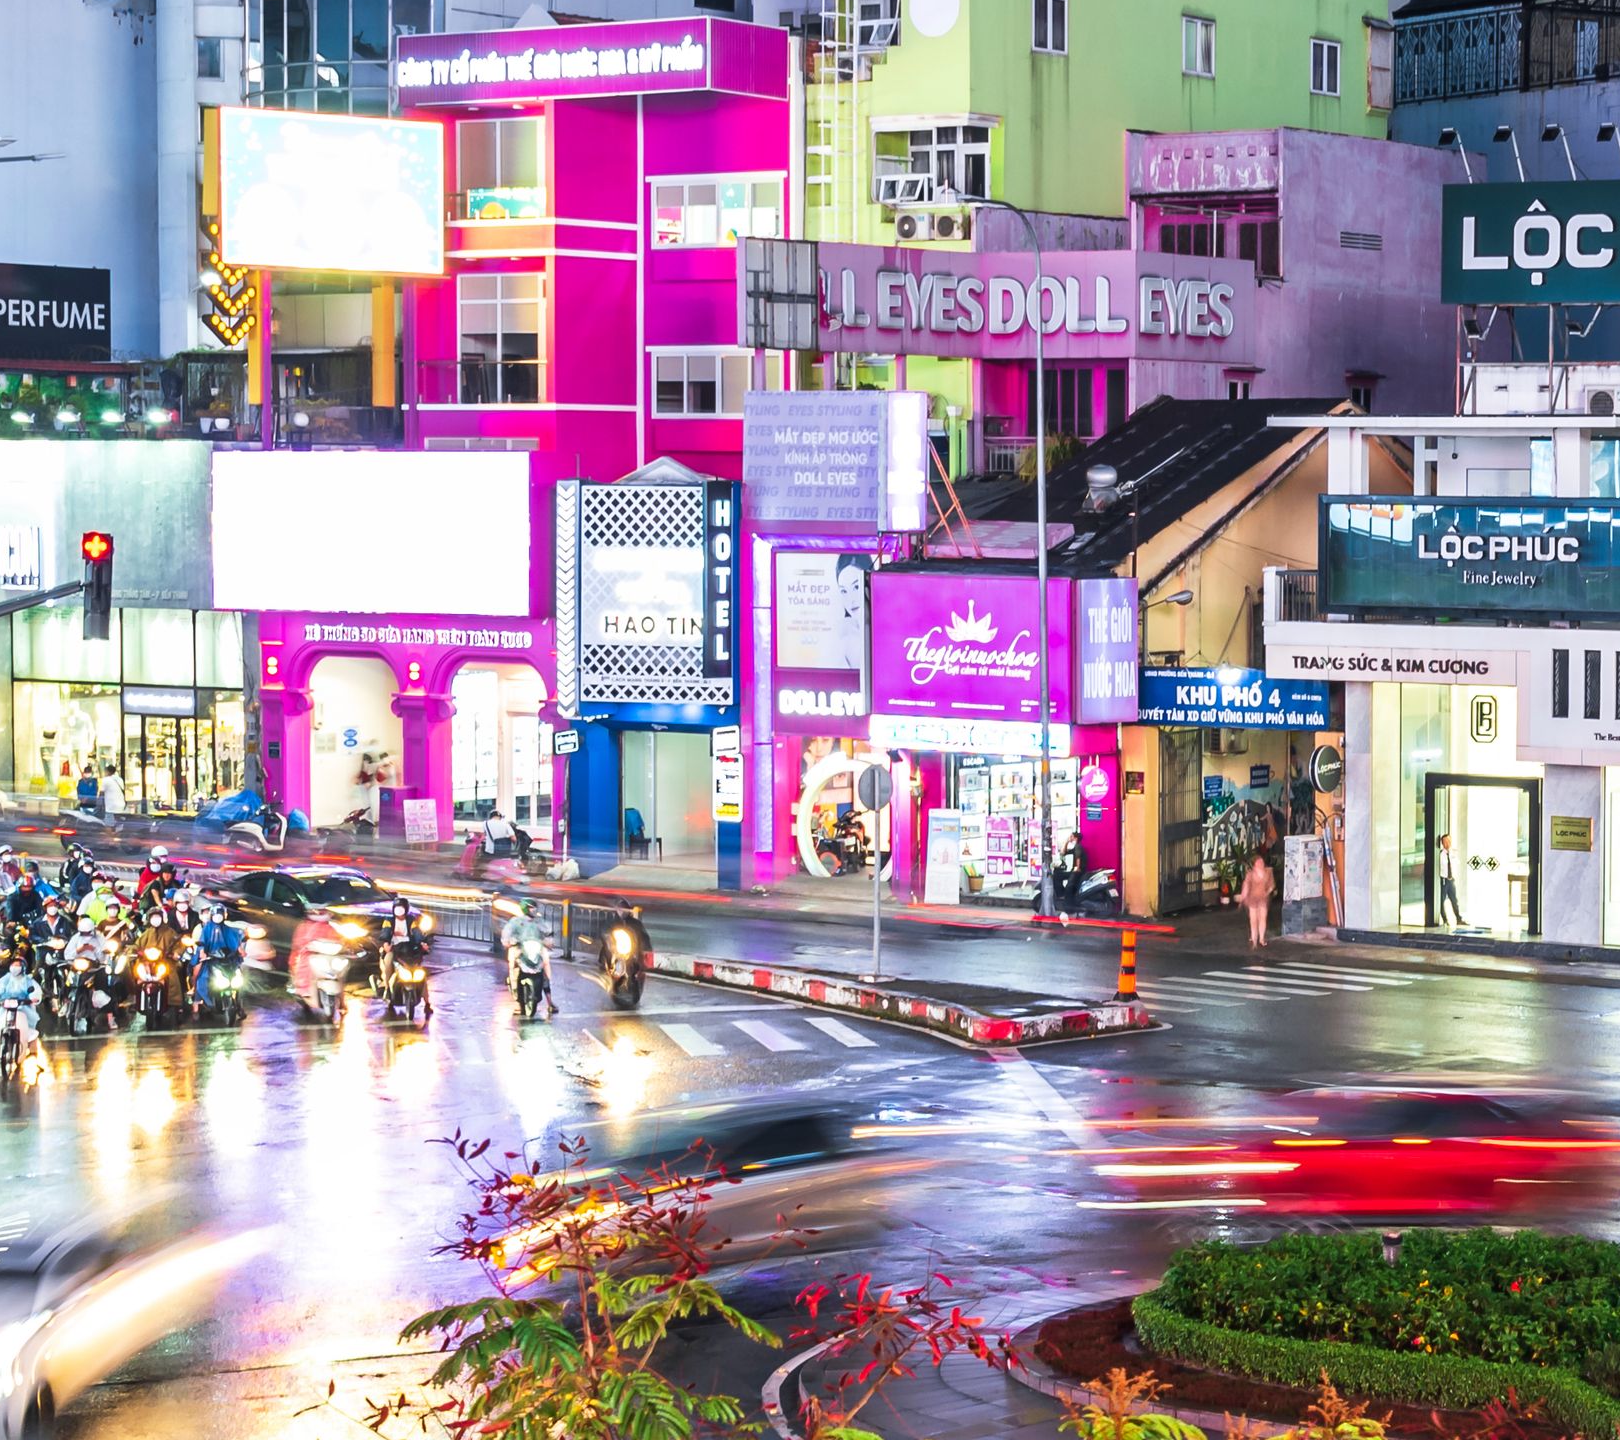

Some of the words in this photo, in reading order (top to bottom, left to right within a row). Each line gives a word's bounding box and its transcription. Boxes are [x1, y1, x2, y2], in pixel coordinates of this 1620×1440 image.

[1462, 198, 1614, 286] LỘC
[877, 269, 984, 334] EYES
[988, 275, 1127, 335] DOLL
[1138, 275, 1234, 339] EYES
[794, 471, 826, 485] DOLL
[827, 471, 857, 485] EYES
[1418, 524, 1484, 568] LỘC
[1488, 524, 1579, 562] PHÚC
[713, 499, 730, 661] HOTEL
[1462, 570, 1489, 585] Fine
[1490, 570, 1537, 588] Jewelry
[1292, 655, 1345, 672] TRANG
[1348, 652, 1378, 672] SỨC
[1380, 659, 1392, 672] &
[1396, 658, 1425, 673] KIM
[1428, 656, 1489, 676] CƯƠNG
[1176, 685, 1217, 706] KHU
[1221, 680, 1263, 707] PHỐ
[1268, 688, 1281, 707] 4
[1594, 732, 1607, 742] The
